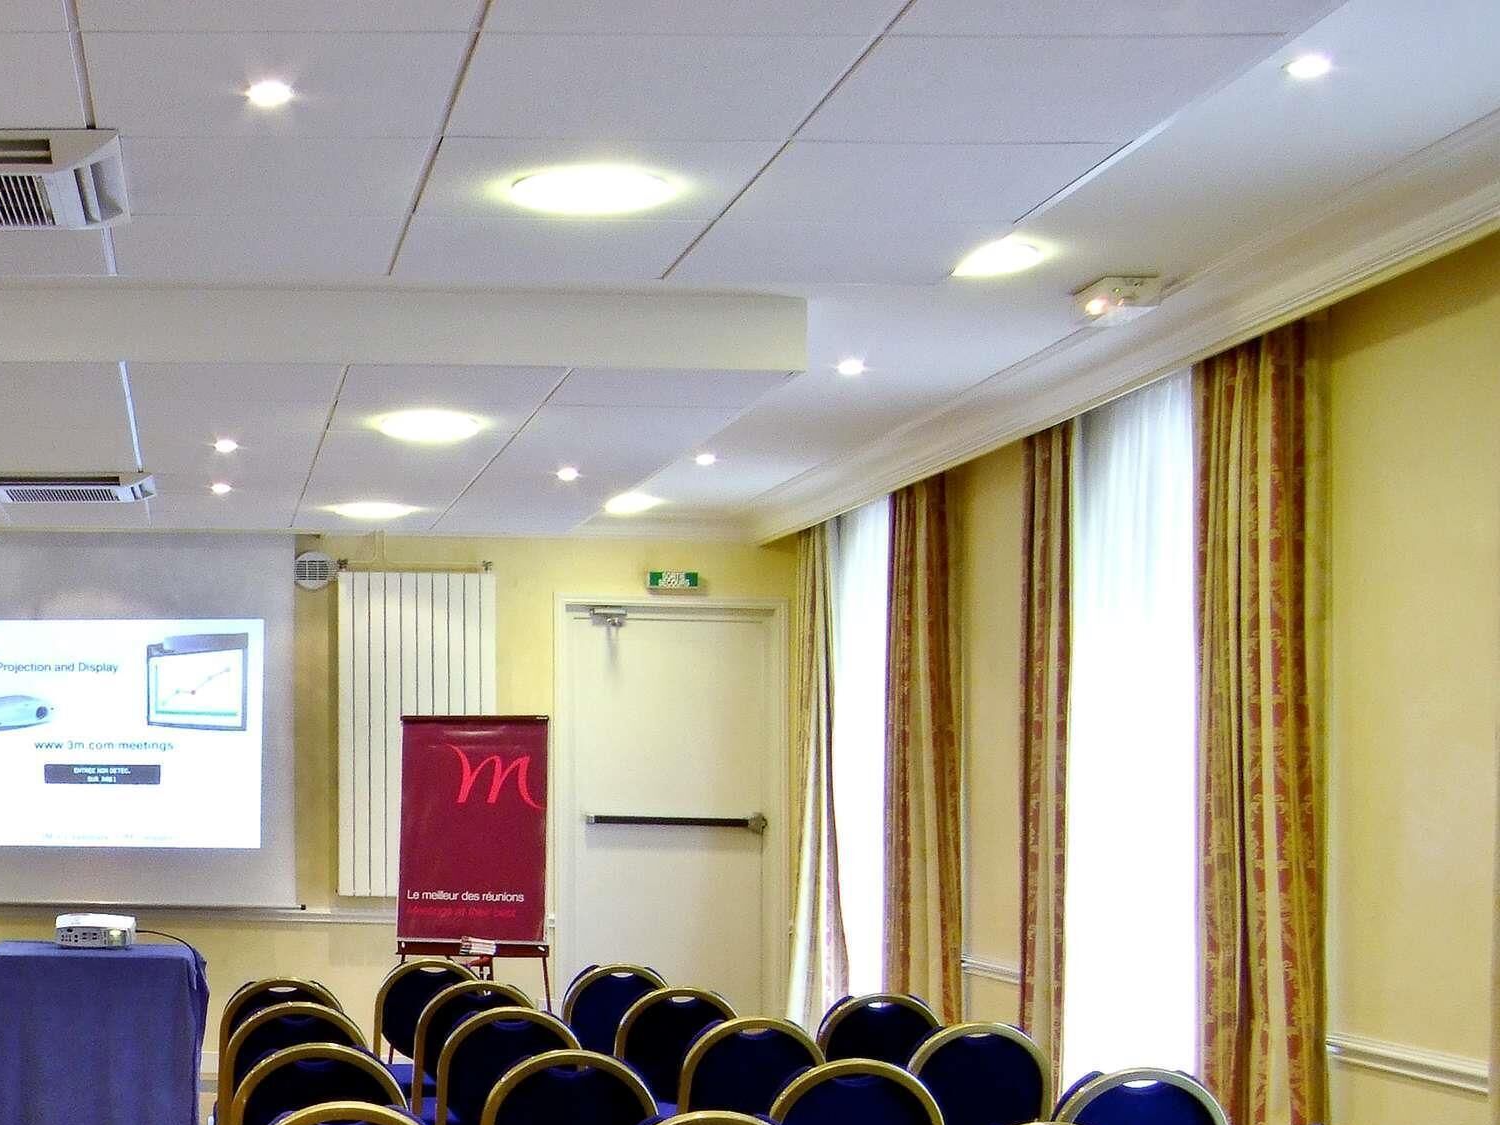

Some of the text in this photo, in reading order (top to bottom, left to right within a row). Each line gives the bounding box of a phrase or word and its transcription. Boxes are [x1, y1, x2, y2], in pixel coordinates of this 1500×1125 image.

[54, 661, 75, 673] and
[78, 661, 119, 675] Display
[407, 889, 525, 903] Le meilleur des réunions
